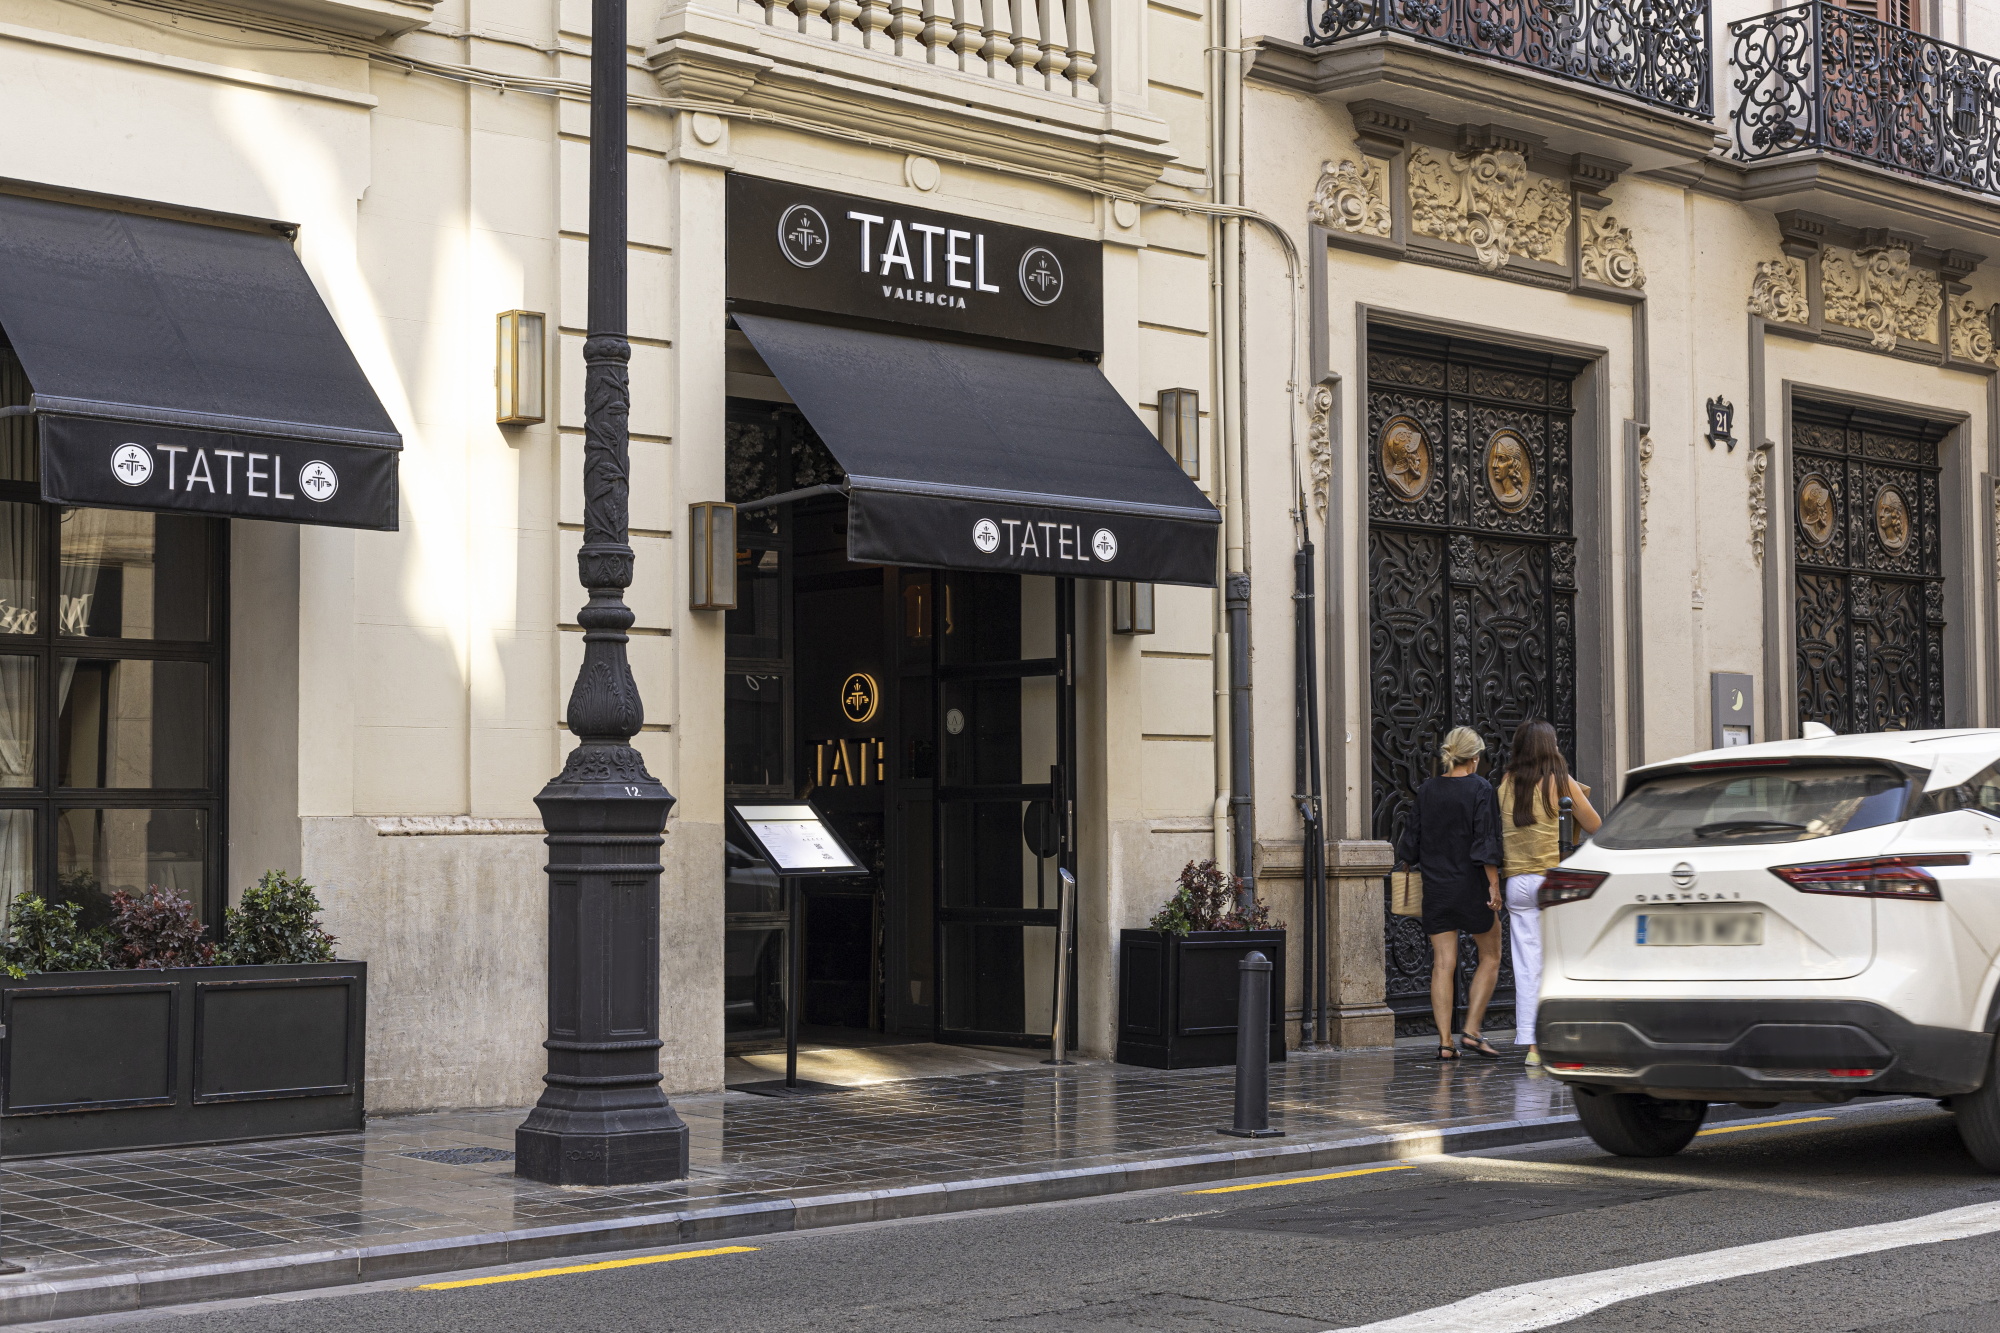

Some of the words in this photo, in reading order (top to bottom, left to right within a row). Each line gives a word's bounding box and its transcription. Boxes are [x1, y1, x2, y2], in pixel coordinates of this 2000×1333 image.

[847, 211, 1000, 293] TATEL
[882, 285, 966, 309] VALENCIA
[1716, 411, 1728, 433] 21
[156, 443, 295, 500] TATEL
[1001, 518, 1090, 561] TATEL
